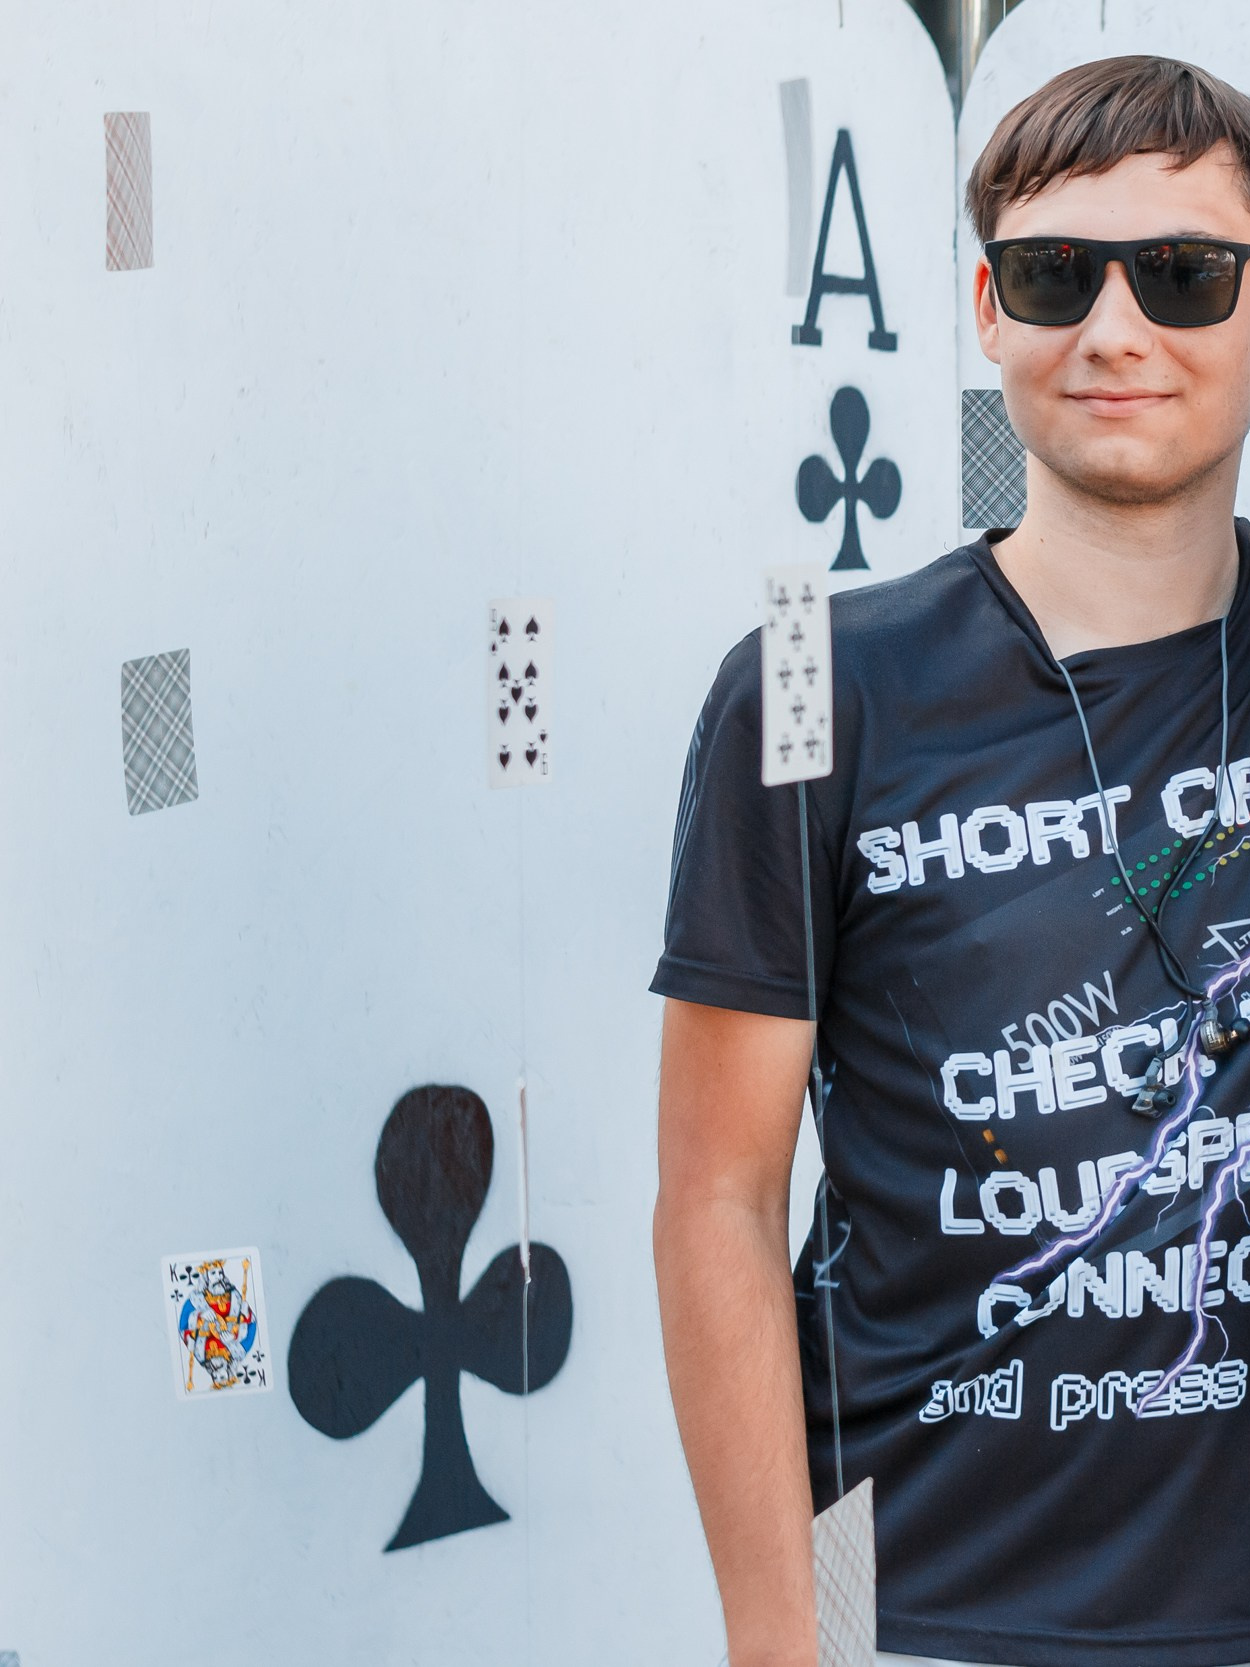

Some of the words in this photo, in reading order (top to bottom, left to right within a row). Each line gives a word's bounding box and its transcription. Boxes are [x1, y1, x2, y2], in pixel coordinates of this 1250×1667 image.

[792, 128, 897, 352] A
[857, 785, 1131, 894] SHORT
[1001, 970, 1118, 1071] 500W
[1050, 1358, 1248, 1431] press
